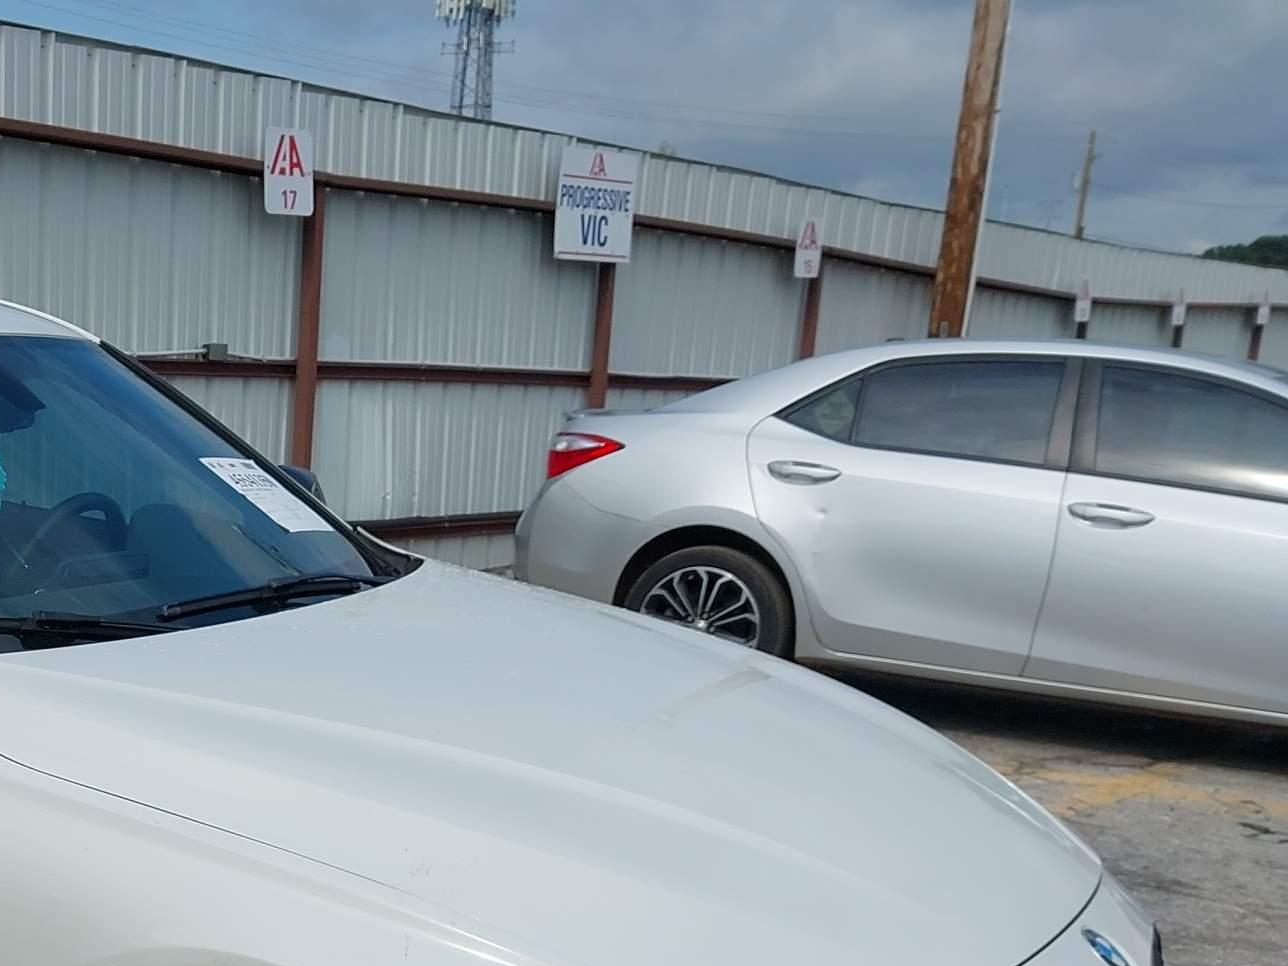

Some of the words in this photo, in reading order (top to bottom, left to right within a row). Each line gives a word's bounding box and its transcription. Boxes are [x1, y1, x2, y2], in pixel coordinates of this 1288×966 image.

[281, 189, 298, 210] 17
[559, 183, 631, 213] PROGRESSIVE
[580, 213, 609, 247] VIC
